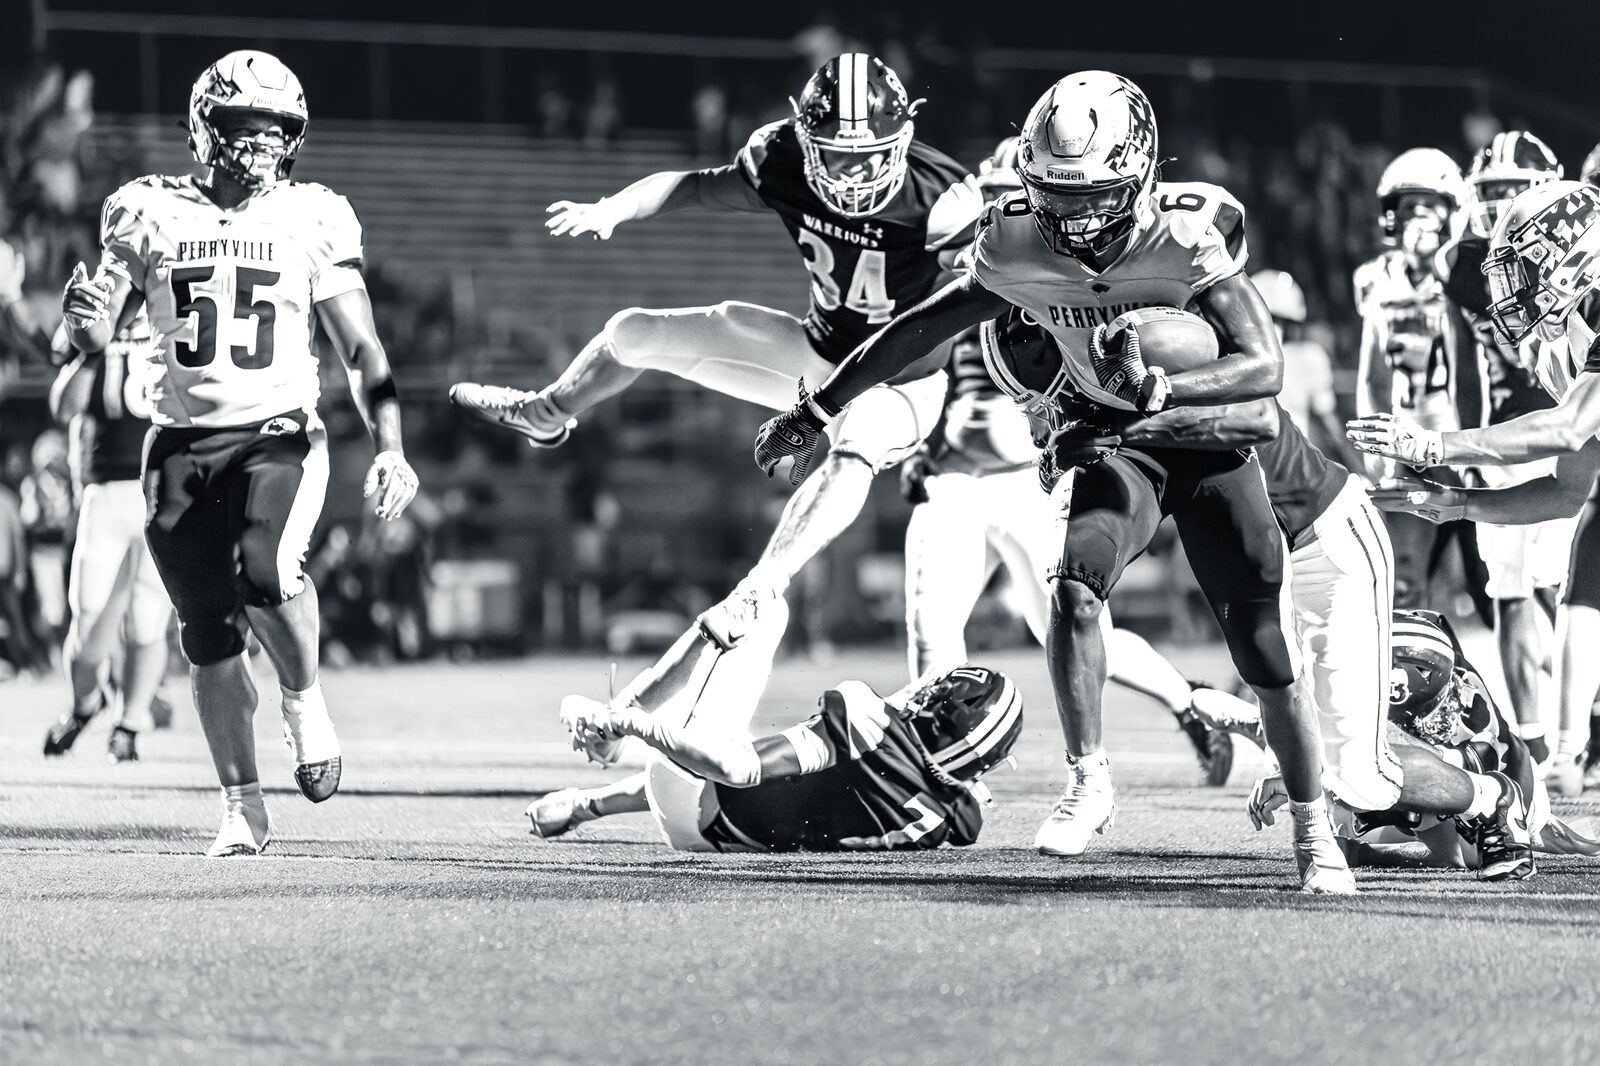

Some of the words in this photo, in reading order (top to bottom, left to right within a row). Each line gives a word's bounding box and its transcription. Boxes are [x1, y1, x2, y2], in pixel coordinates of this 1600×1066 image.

[1047, 170, 1085, 181] Riddell
[1159, 193, 1207, 213] 6
[178, 239, 273, 262] PERRYVILLE
[798, 227, 896, 324] 34
[171, 265, 281, 370] 55
[1048, 303, 1148, 329] PERRYV
